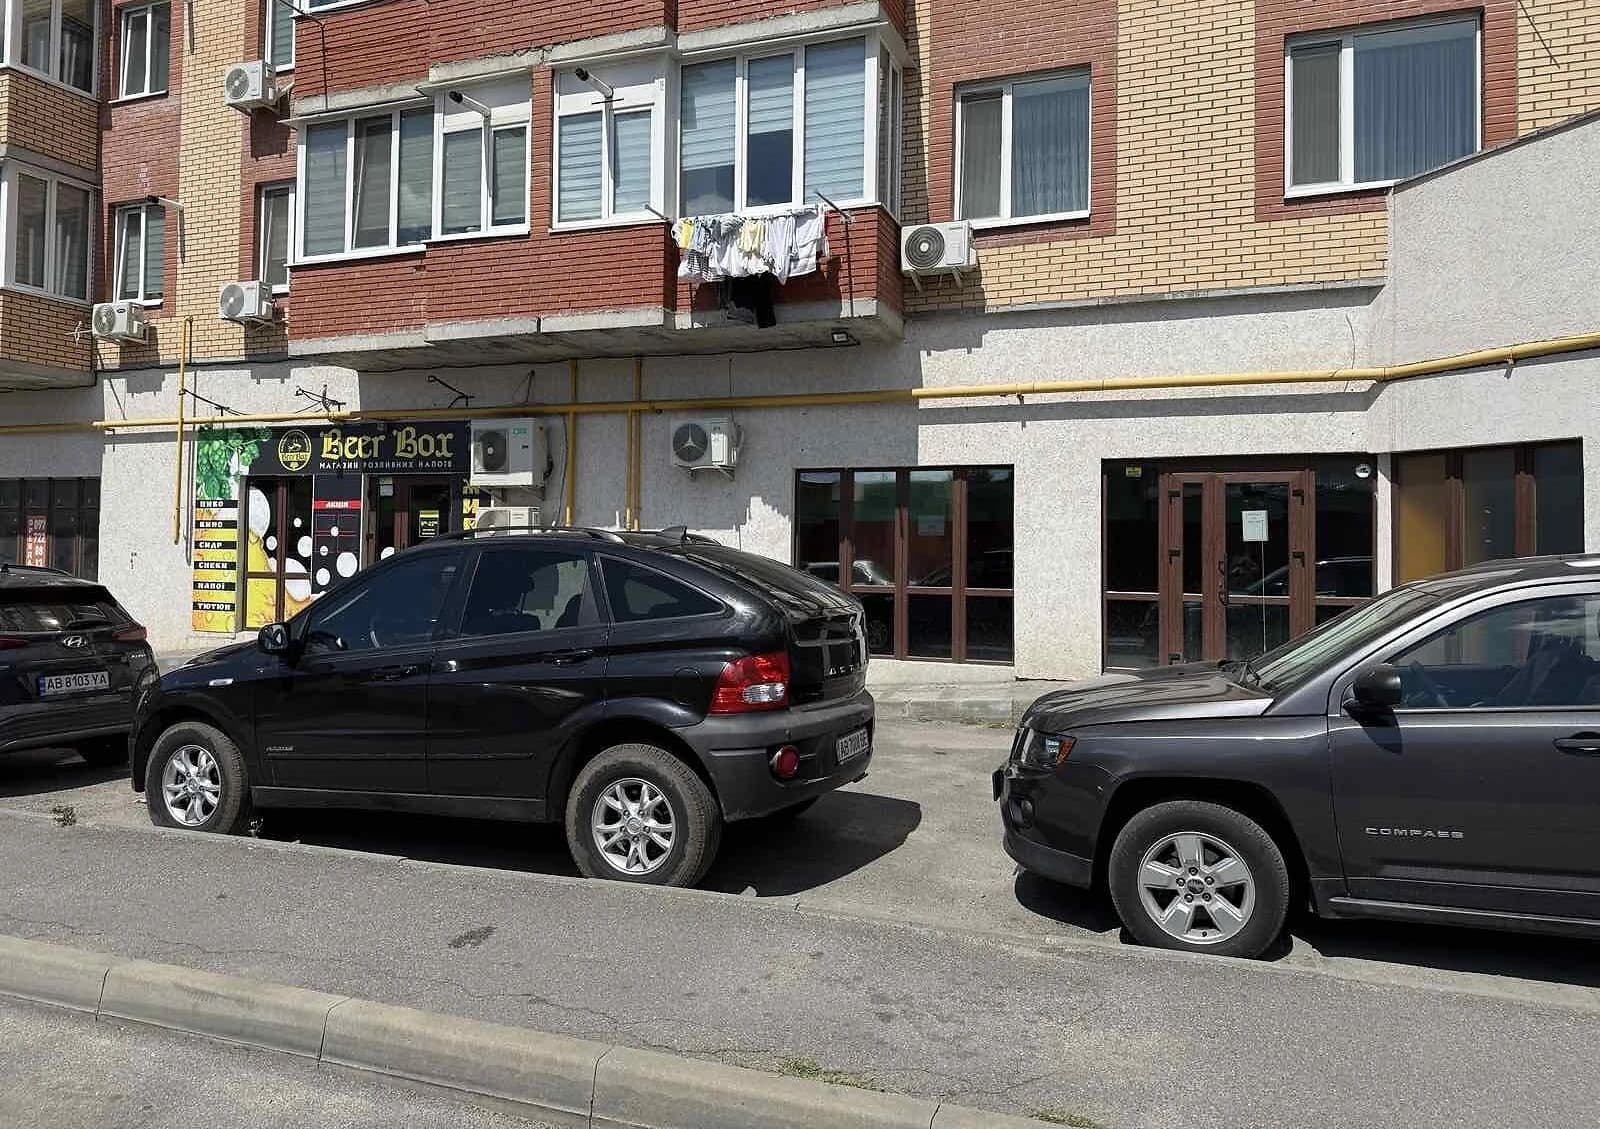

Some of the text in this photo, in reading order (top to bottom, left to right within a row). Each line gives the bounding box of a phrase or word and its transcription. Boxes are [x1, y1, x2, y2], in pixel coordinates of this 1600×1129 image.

[320, 426, 454, 460] Beer Box
[319, 460, 359, 470] МАГАЗИН
[47, 673, 107, 690] AB 8103 YA
[1365, 827, 1464, 839] COMPASS
